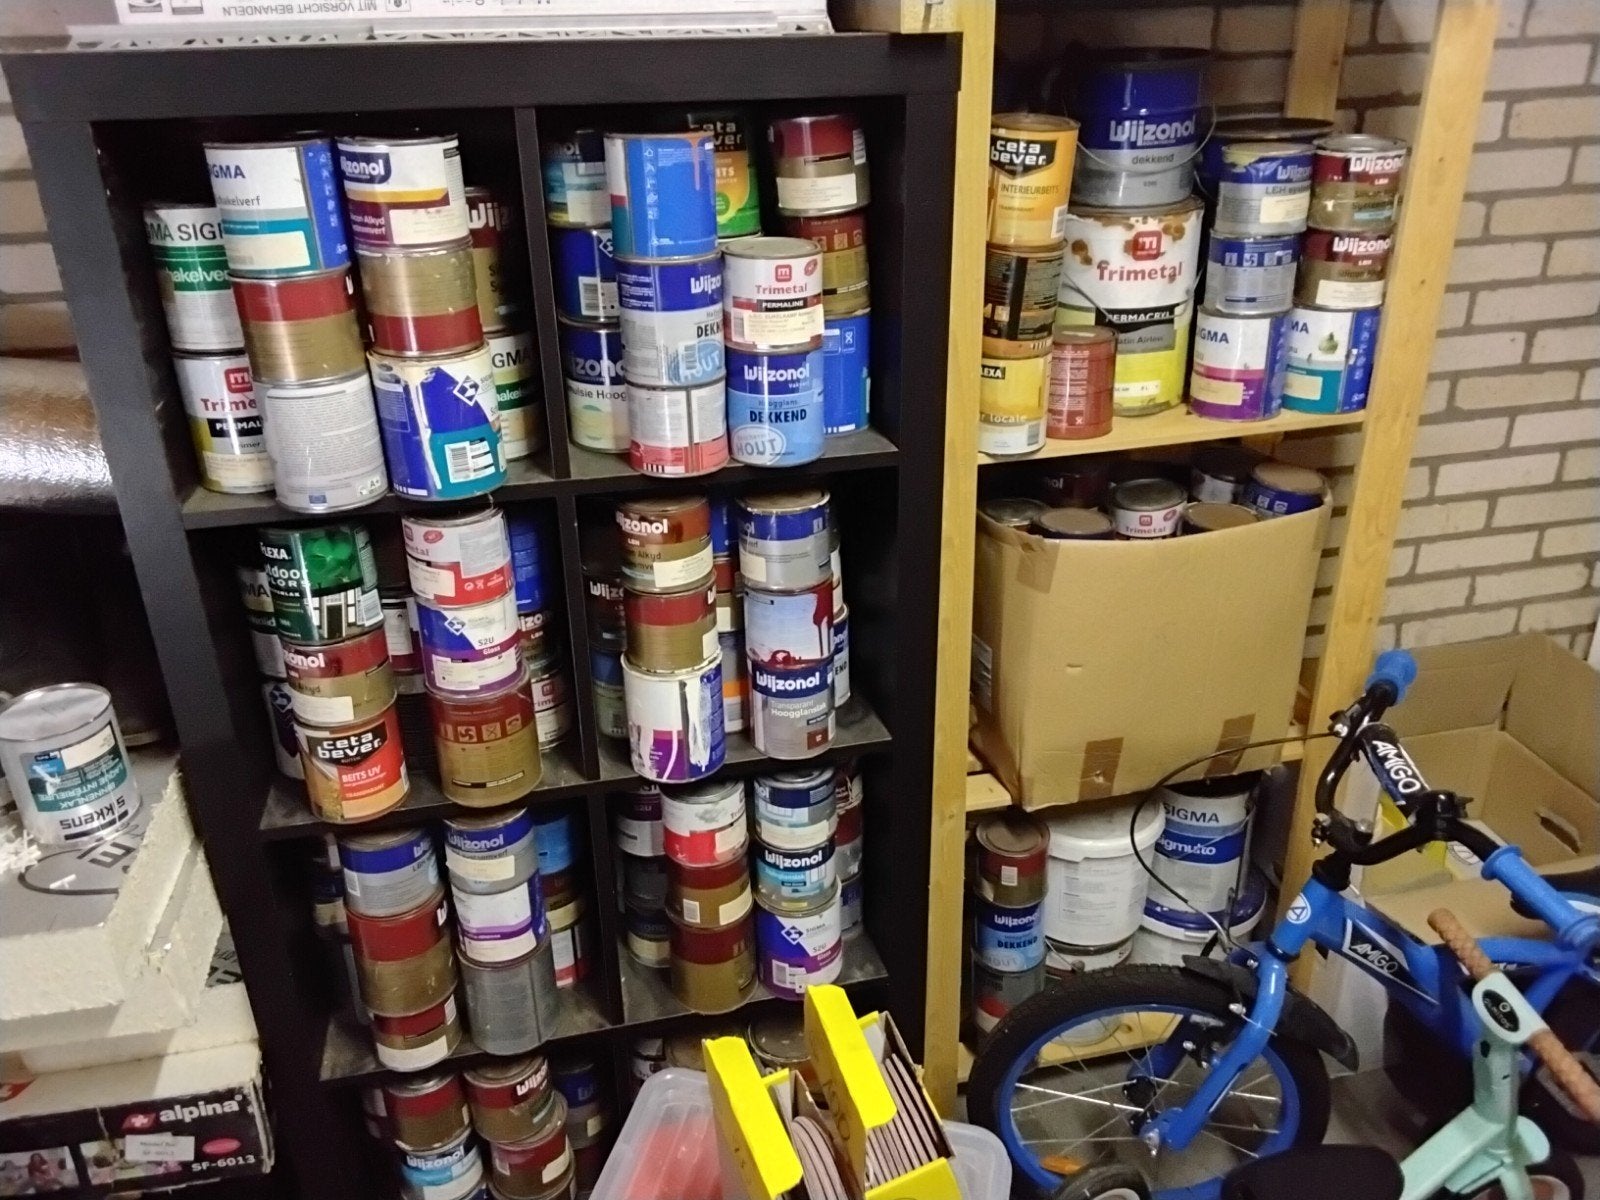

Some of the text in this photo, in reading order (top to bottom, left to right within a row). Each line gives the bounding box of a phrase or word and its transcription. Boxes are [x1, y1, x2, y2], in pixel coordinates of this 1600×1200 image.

[222, 4, 293, 17] BEHANDELN
[297, 2, 354, 15] VORSICHT
[1109, 114, 1196, 146] Wijzonol
[996, 139, 1041, 154] ceta
[1132, 153, 1175, 165] dekkend
[1097, 260, 1183, 283] Trimetal
[755, 282, 808, 296] Trimetal
[762, 300, 804, 309] PERMALINE
[744, 363, 810, 386] Wijzonol
[756, 671, 820, 693] Wijzonol
[317, 738, 382, 760] bever
[323, 730, 374, 750] ceta
[342, 767, 367, 783] BEITS
[368, 765, 382, 777] UV
[1372, 739, 1422, 794] AMIGO
[765, 850, 823, 870] Wijzonol
[1351, 942, 1399, 976] AMIGO
[159, 1099, 240, 1123] alpina
[191, 1154, 256, 1173] SF-6013
